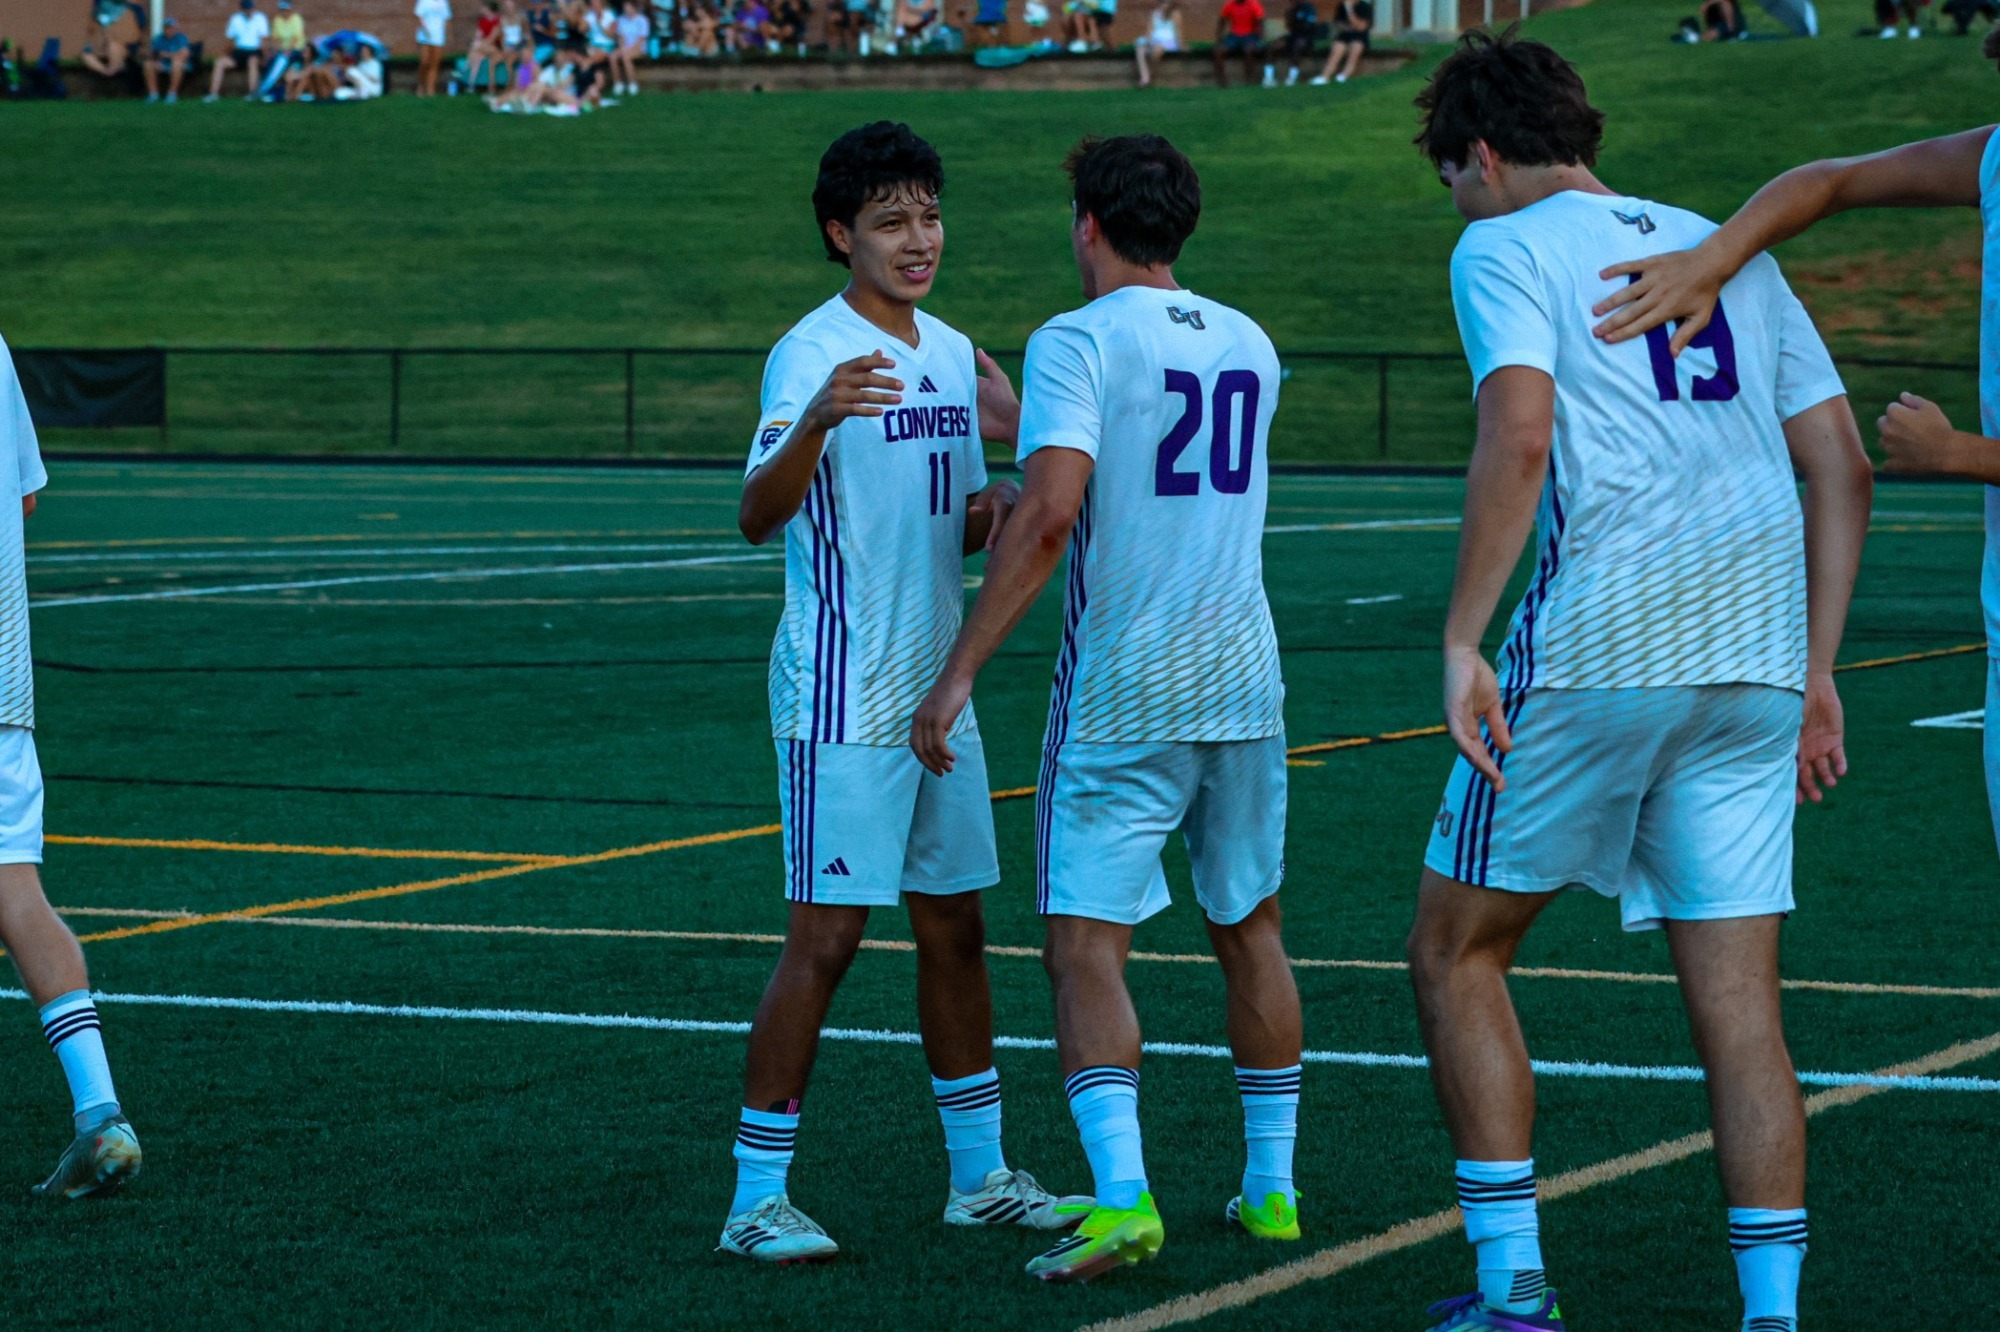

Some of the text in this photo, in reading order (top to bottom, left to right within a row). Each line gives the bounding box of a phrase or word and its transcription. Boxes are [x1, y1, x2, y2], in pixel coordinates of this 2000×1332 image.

[1165, 306, 1206, 330] CU
[1155, 368, 1260, 496] 20
[928, 451, 950, 516] 11
